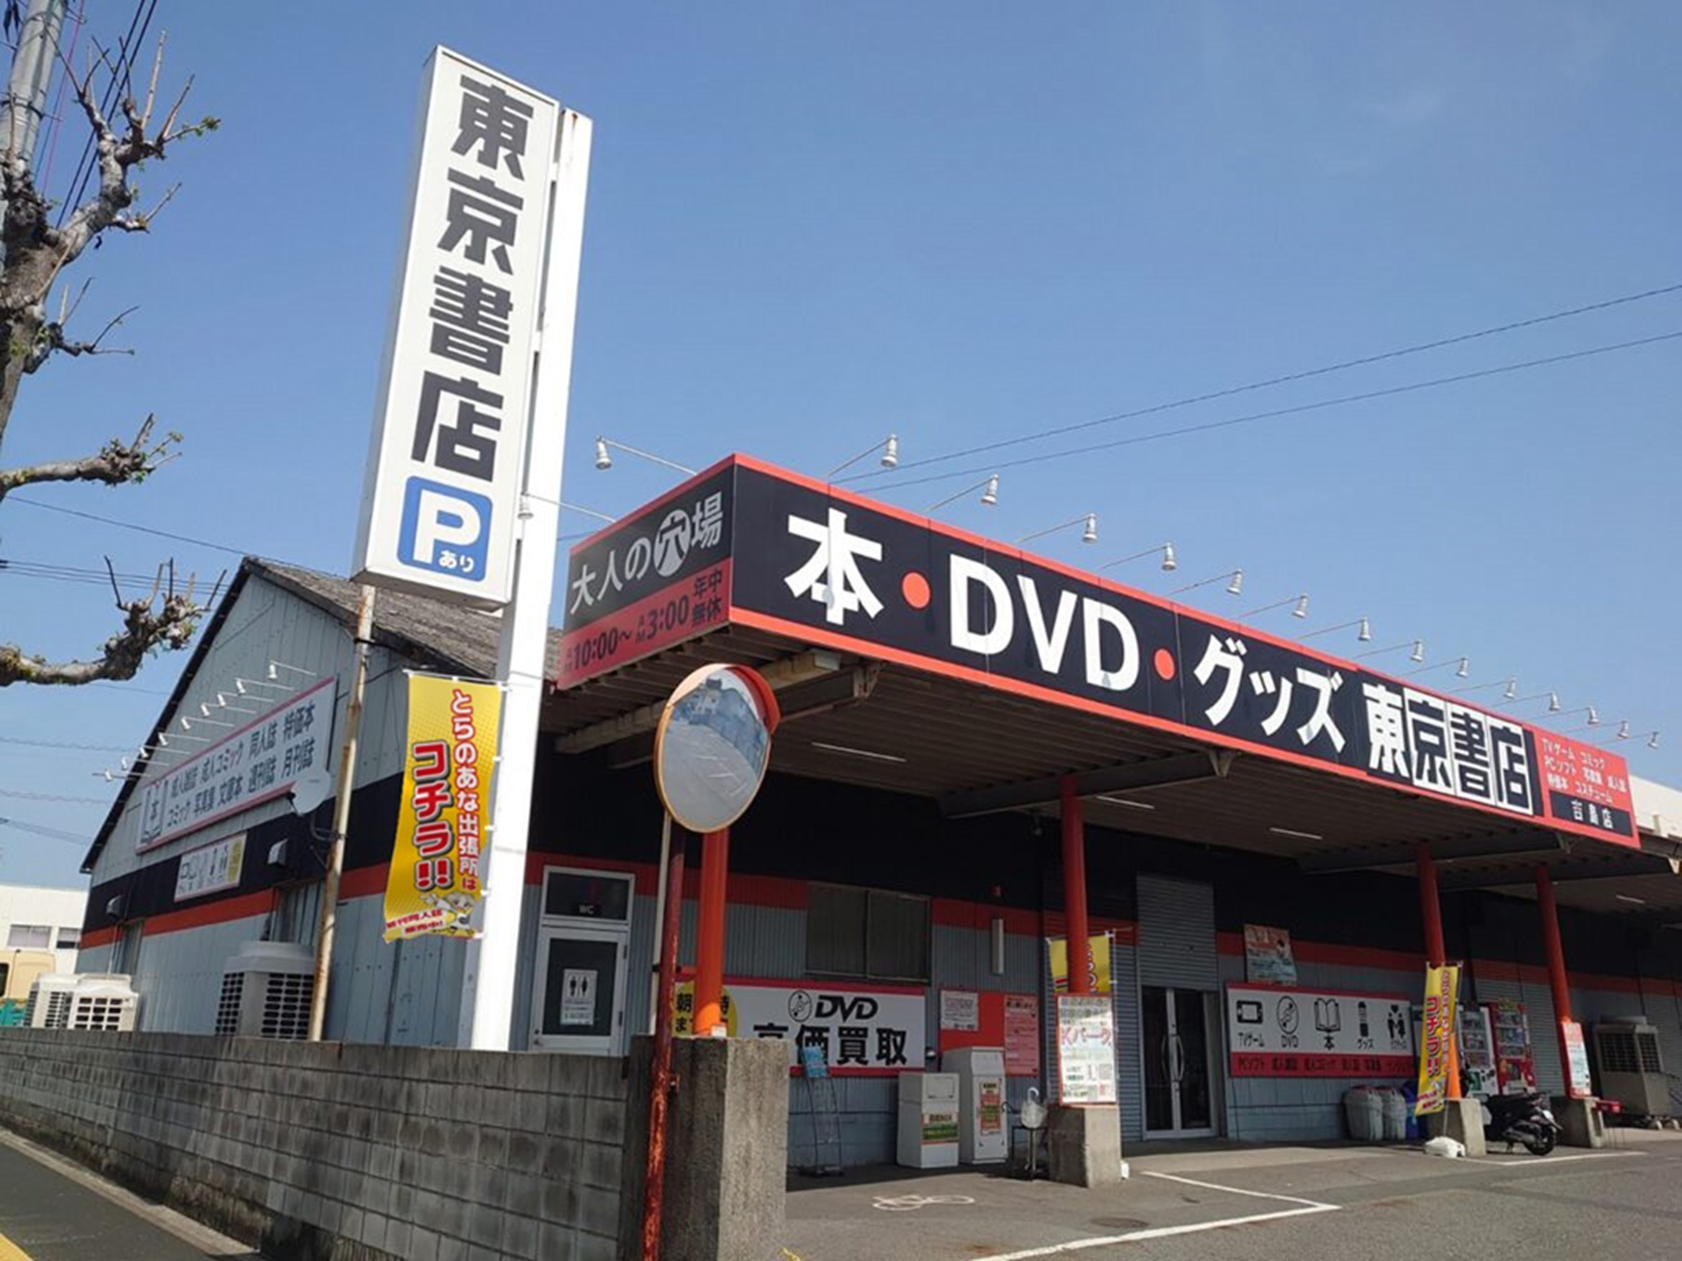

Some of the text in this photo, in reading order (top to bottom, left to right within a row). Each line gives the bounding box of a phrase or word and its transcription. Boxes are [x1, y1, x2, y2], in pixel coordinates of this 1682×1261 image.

[410, 73, 534, 483] 東京書店
[413, 488, 482, 565] P
[569, 490, 724, 616] 大人の穴場
[438, 550, 475, 573] あり
[693, 567, 724, 598] 年中
[692, 597, 723, 627] 無休
[1362, 682, 1533, 813] 東京書店
[450, 688, 480, 891] とらのあな出張所は
[814, 994, 879, 1024] DVD
[1323, 1034, 1336, 1051] 本
